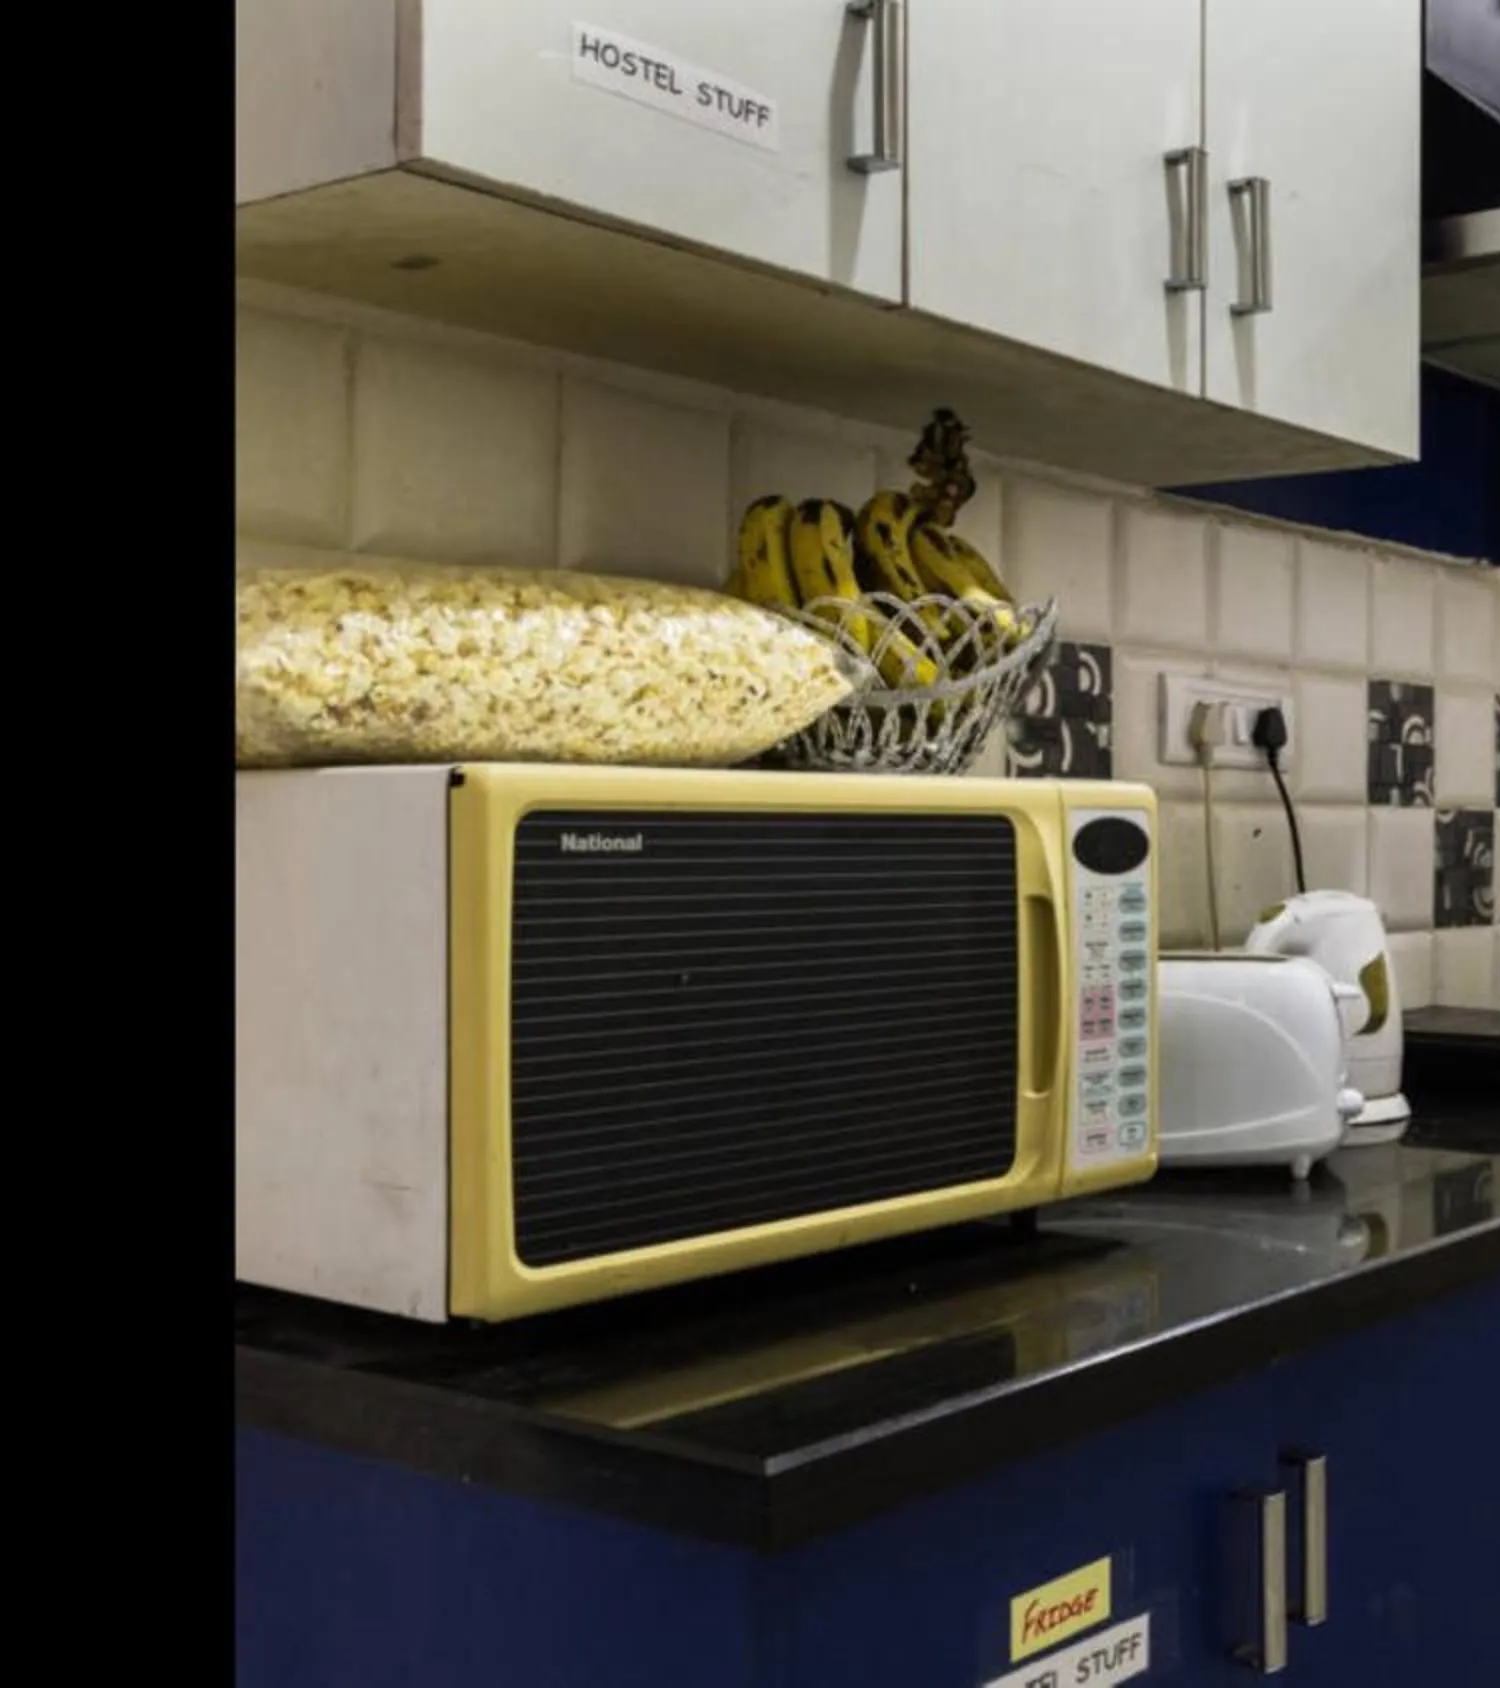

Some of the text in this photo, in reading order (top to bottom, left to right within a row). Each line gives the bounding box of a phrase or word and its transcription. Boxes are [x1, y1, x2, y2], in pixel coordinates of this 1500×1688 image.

[579, 32, 770, 128] HOSTEL STUFF
[560, 831, 643, 852] National
[1021, 1587, 1099, 1645] FRIDGE
[1075, 1631, 1143, 1684] STUFF
